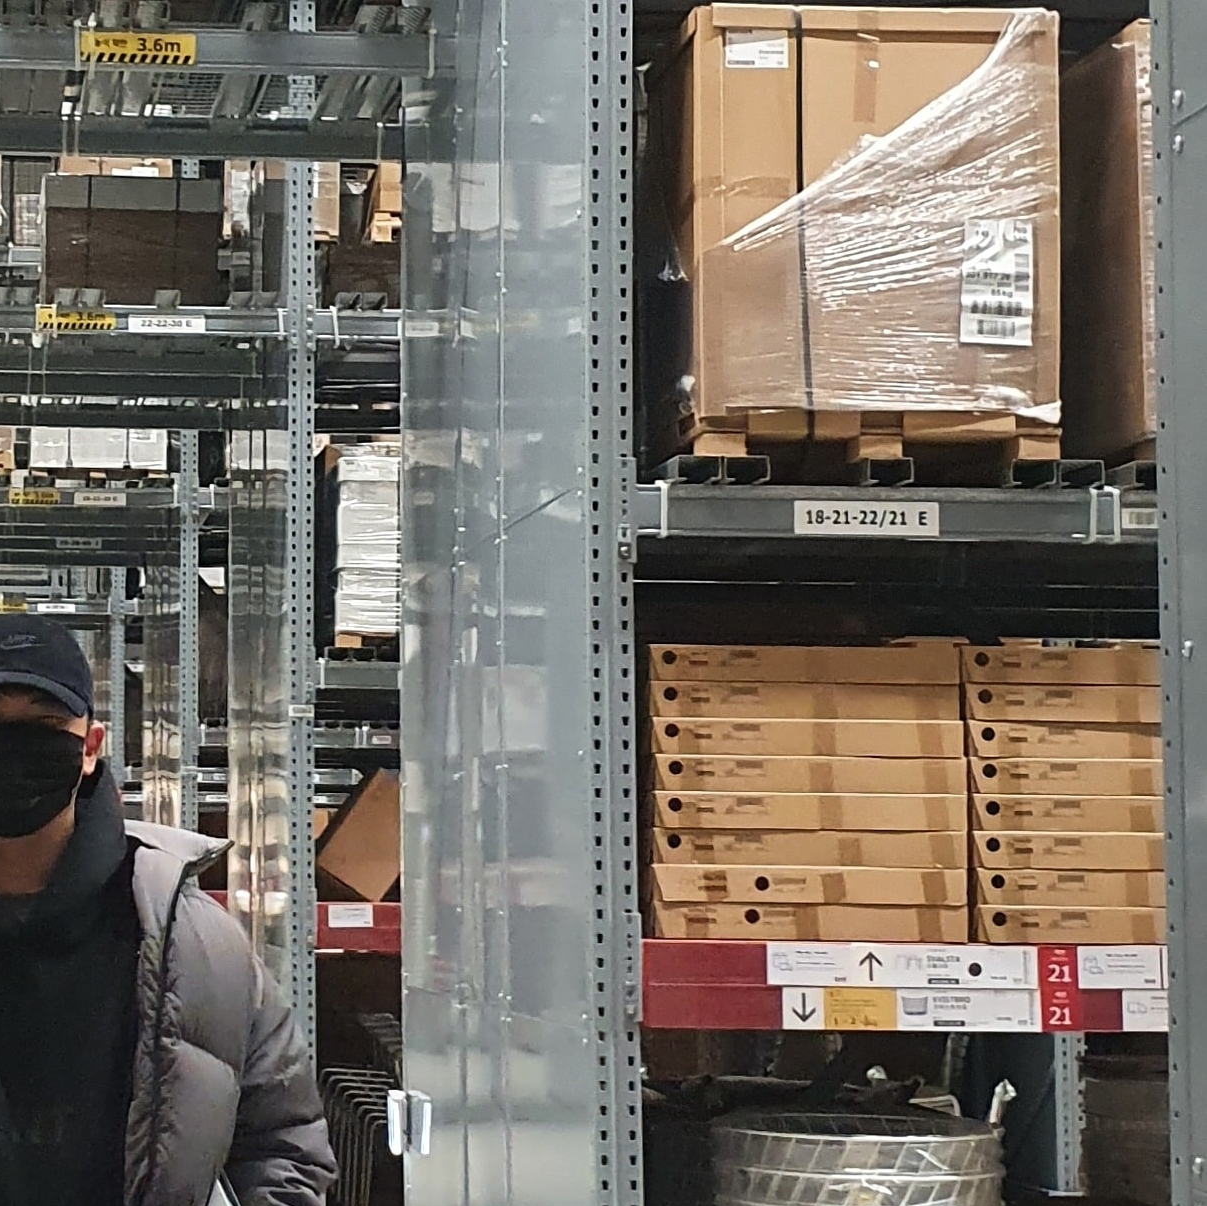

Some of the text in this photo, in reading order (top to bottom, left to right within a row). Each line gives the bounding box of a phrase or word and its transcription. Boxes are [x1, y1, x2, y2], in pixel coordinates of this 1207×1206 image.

[136, 37, 181, 53] 3.6m
[185, 319, 193, 327] E
[805, 509, 928, 528] 18-21-22/21 E
[1047, 964, 1073, 983] 21
[1048, 1006, 1073, 1025] 21
